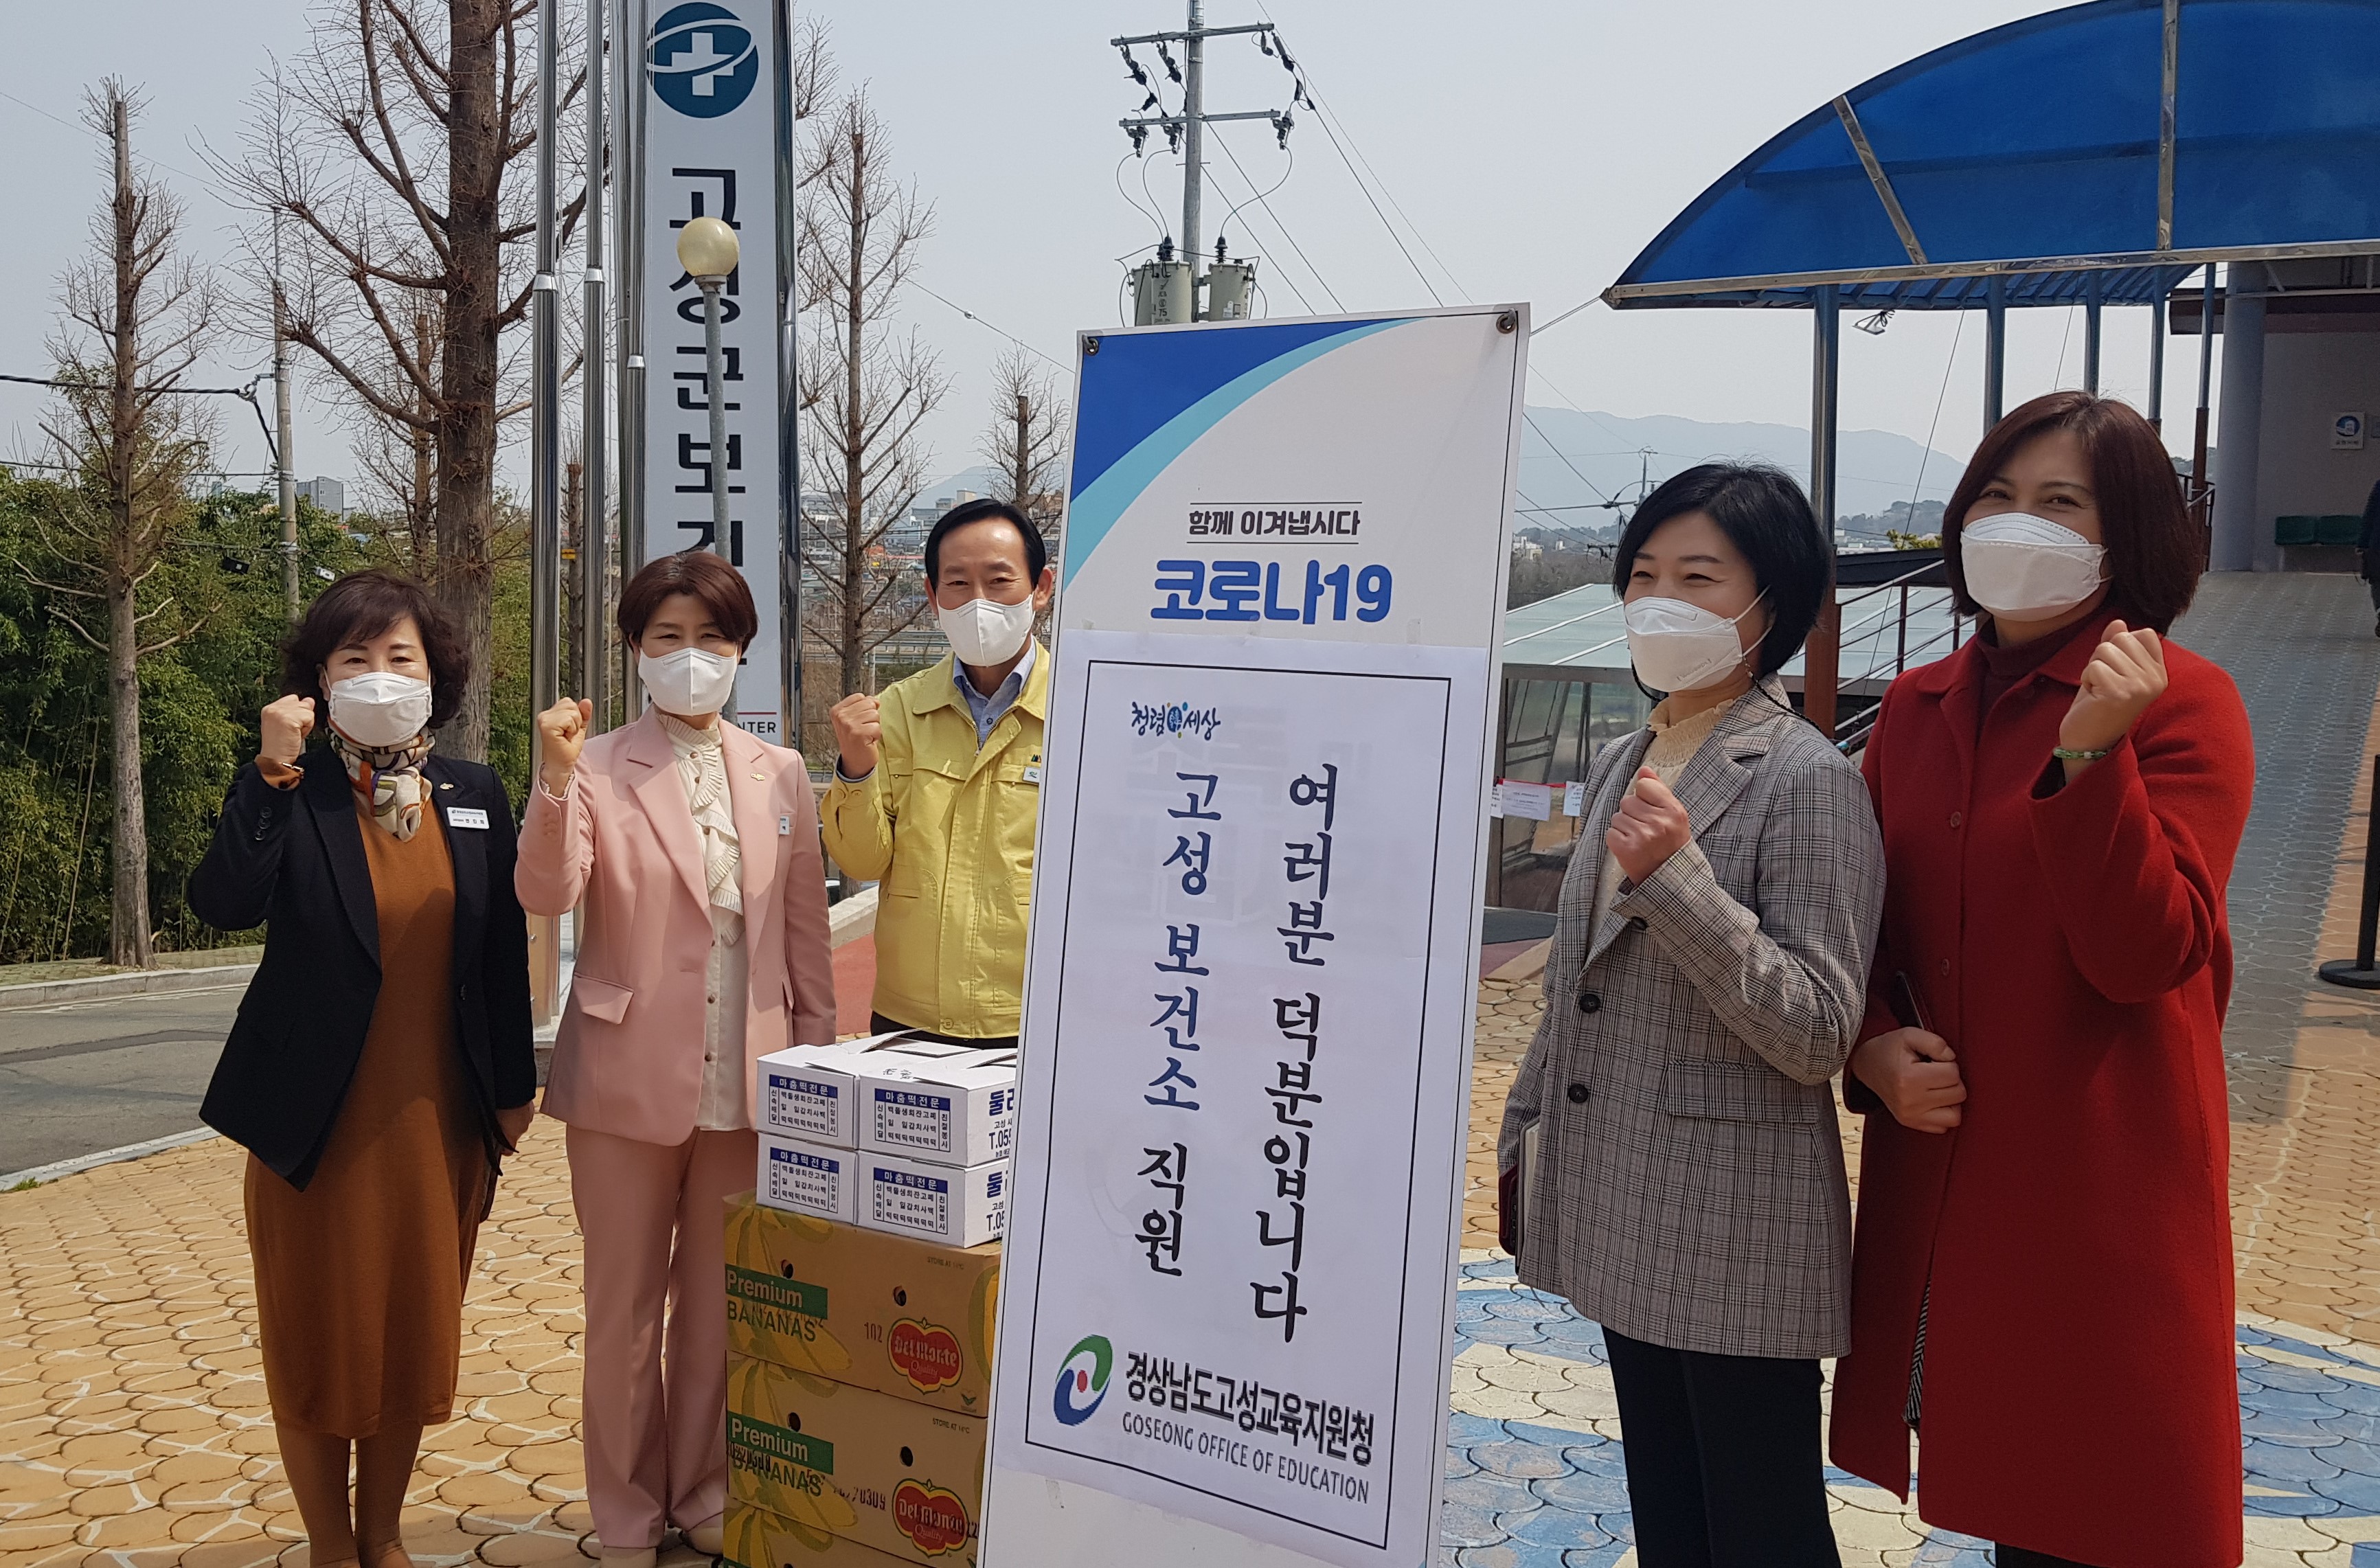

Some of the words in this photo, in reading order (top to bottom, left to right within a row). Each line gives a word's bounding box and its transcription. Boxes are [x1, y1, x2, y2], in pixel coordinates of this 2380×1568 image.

[1189, 510, 1233, 536] 함께
[1240, 510, 1361, 536] 이겨냅시다
[1151, 559, 1392, 625] 코로나19
[1162, 771, 1222, 896] 고성
[1276, 763, 1338, 966] 여러분
[1143, 923, 1210, 1111] 보건소
[987, 1170, 1008, 1198] 둘
[1249, 992, 1322, 1343] 덕분입니다
[1135, 1142, 1188, 1277] 직원
[727, 1271, 802, 1308] Premium
[727, 1300, 816, 1342] BANANAS
[894, 1336, 915, 1358] Del
[916, 1342, 957, 1367] Monte
[911, 1360, 938, 1378] Quality
[1125, 1351, 1374, 1466] 경상남도고성교육지원청
[732, 1418, 808, 1462] Premium
[1122, 1412, 1194, 1450] GOSEONG
[1198, 1432, 1248, 1468] OFFICE
[1252, 1448, 1273, 1474] OF
[1278, 1455, 1369, 1504] EDUCATION
[732, 1449, 821, 1497] BANANAS
[898, 1498, 917, 1520] Del
[915, 1524, 943, 1543] Quality
